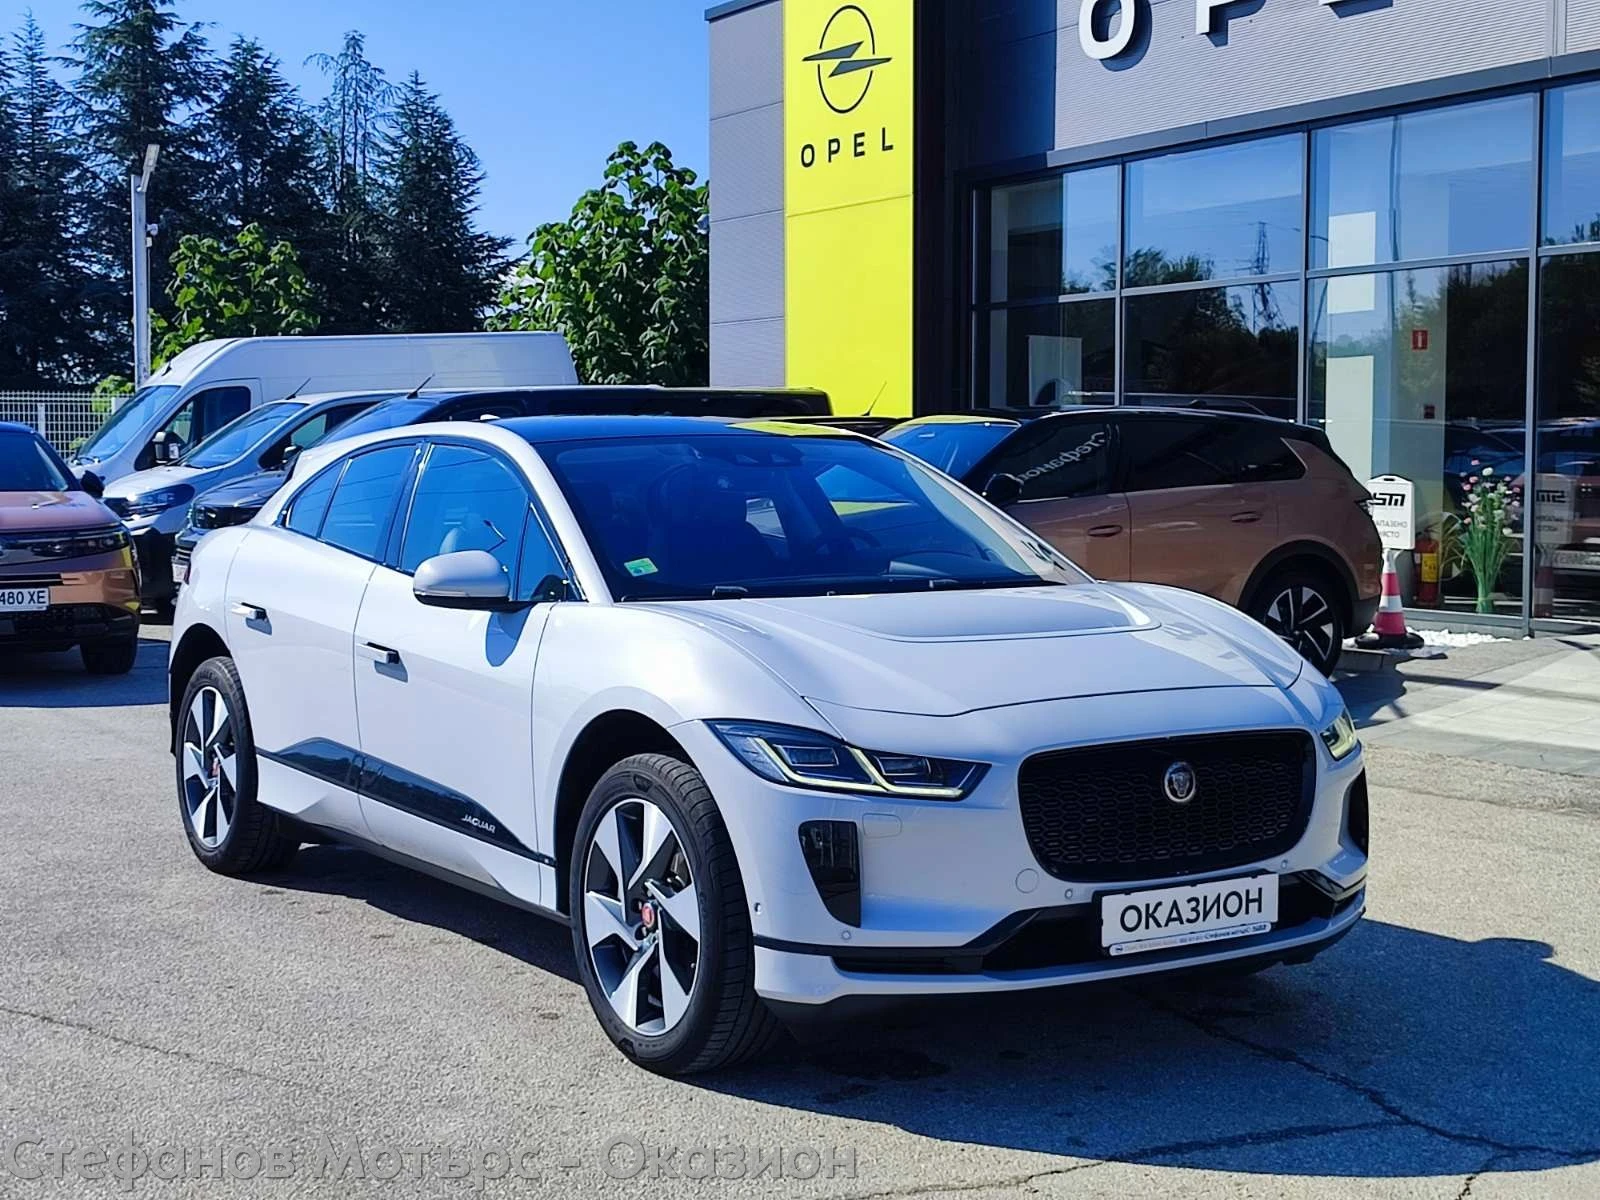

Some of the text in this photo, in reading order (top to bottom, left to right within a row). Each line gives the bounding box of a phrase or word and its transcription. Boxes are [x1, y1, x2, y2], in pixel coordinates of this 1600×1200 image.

[800, 127, 893, 168] OPEL
[0, 590, 46, 605] 480 XE
[1120, 888, 1263, 932] ОКАЗИОН
